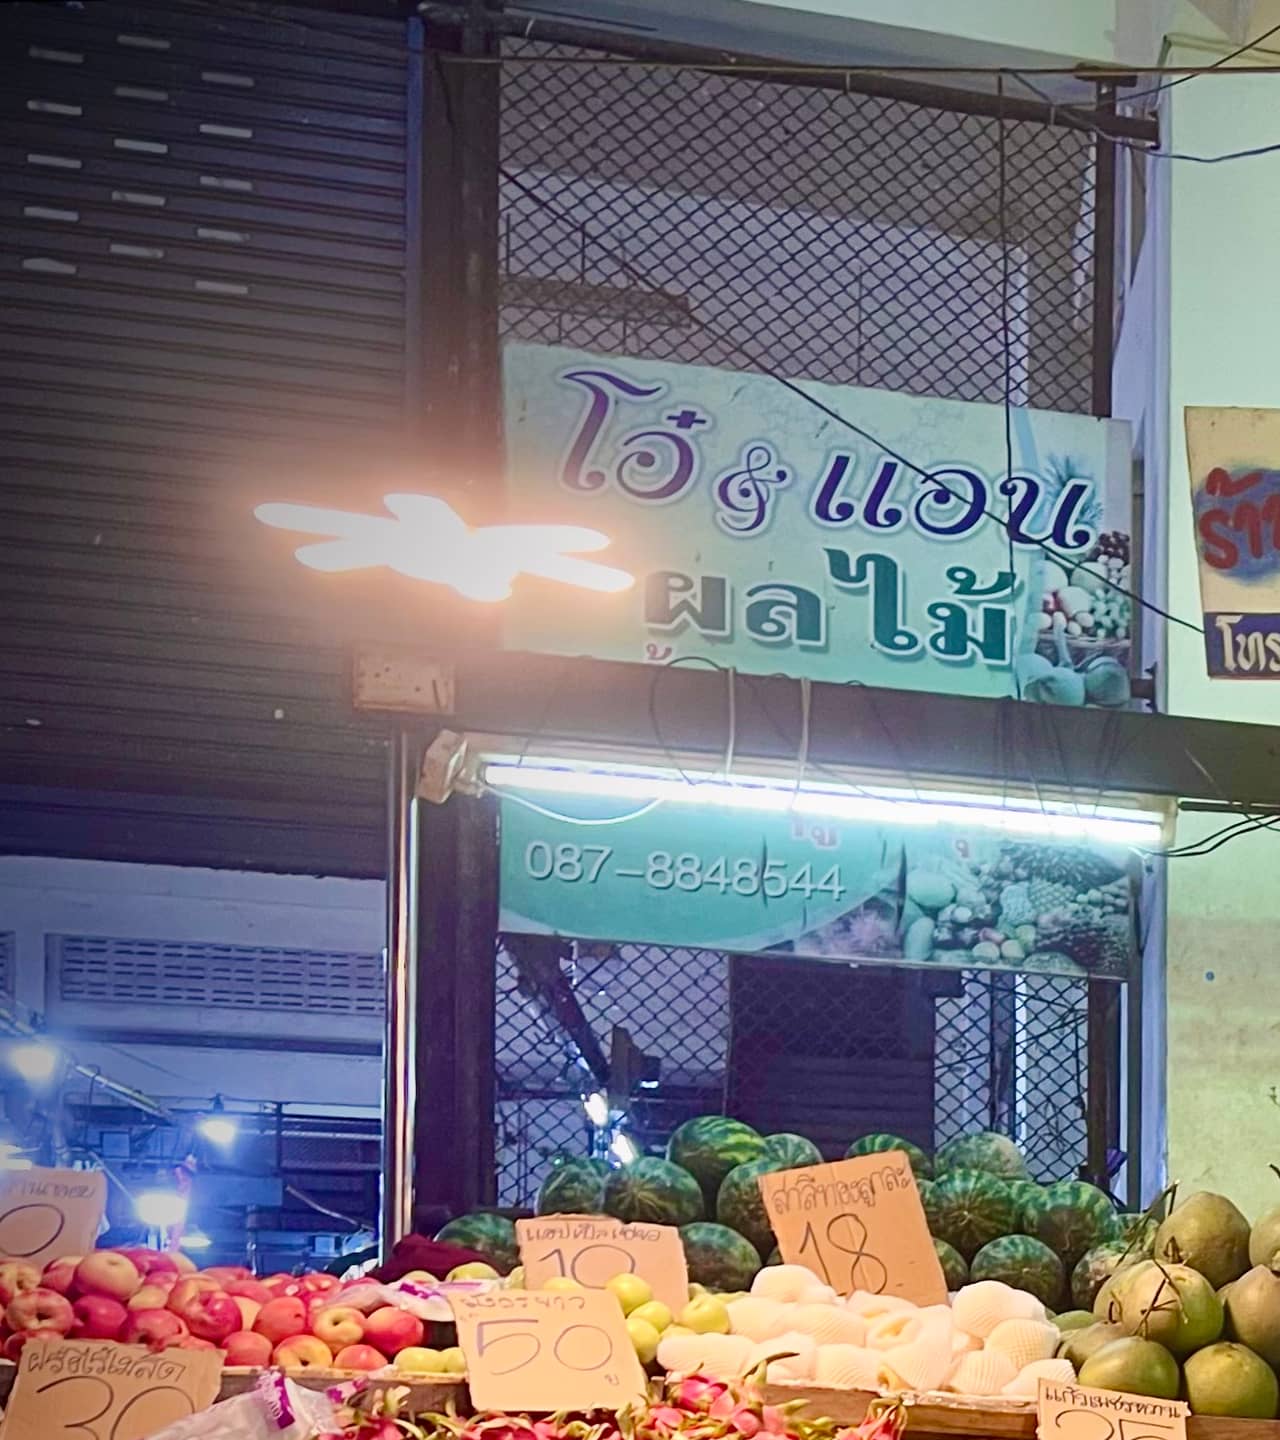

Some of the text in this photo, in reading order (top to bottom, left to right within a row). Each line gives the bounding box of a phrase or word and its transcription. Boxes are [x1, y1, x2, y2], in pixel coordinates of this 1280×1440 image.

[559, 368, 709, 503] โอ๋
[811, 451, 1095, 553] แอน
[642, 545, 1019, 666] ผลไม้
[525, 838, 847, 905] 087-8848544
[537, 1243, 636, 1290] 10
[799, 1212, 888, 1296] 18
[475, 1318, 614, 1377] 50
